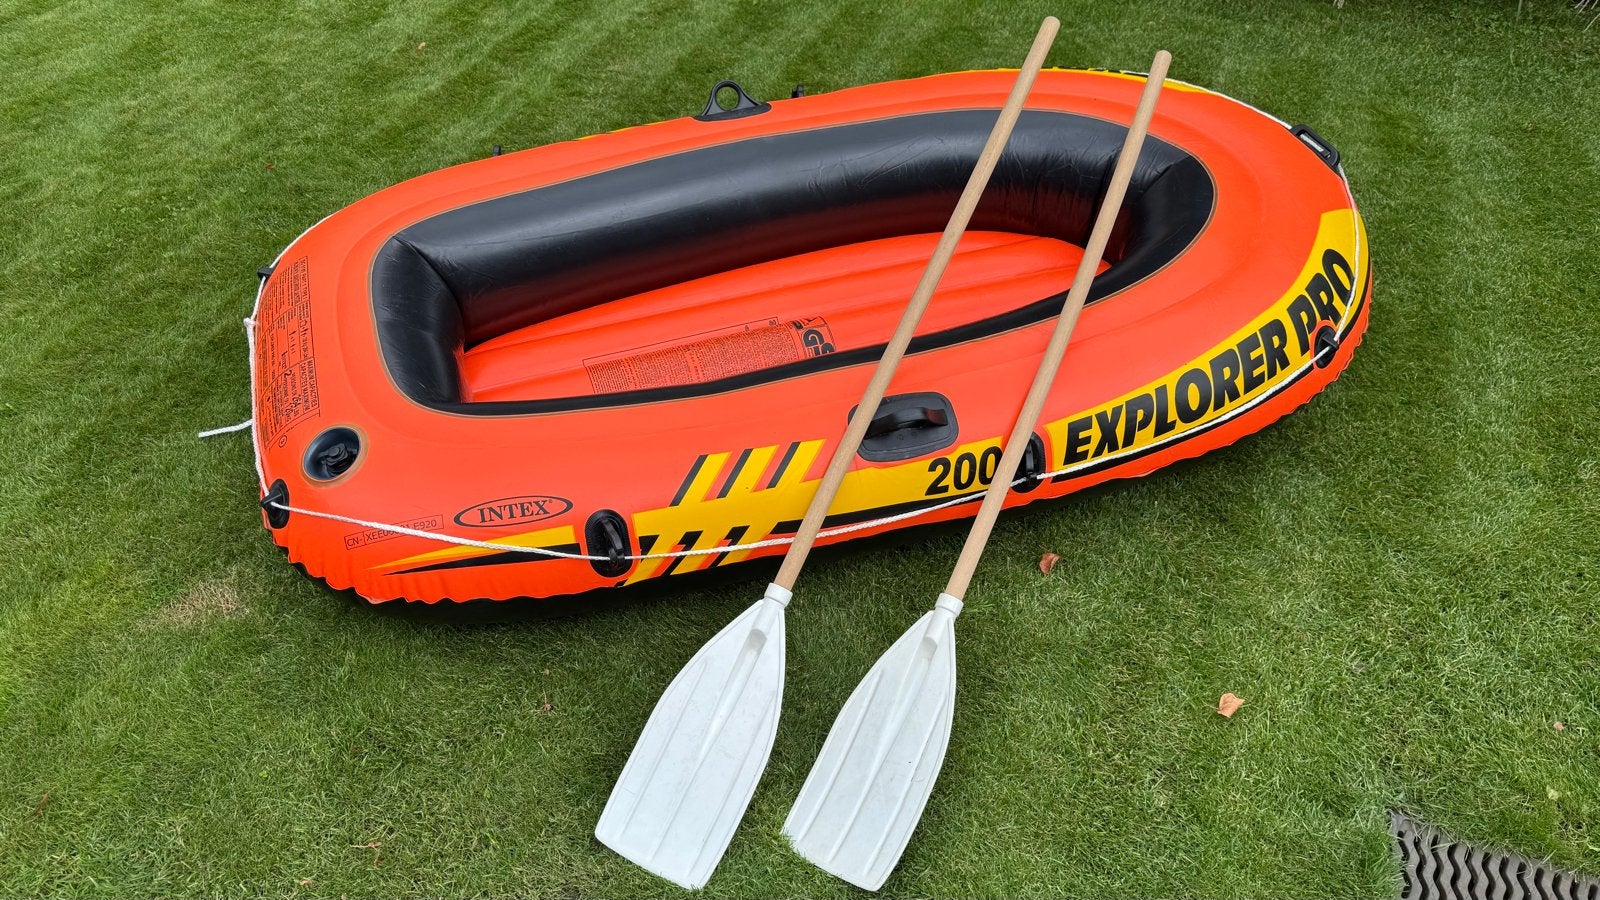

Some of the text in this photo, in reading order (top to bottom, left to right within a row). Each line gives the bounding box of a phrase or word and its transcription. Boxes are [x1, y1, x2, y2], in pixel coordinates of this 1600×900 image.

[1063, 248, 1356, 466] EXPLORER PRO
[924, 446, 1004, 496] 200
[477, 499, 551, 524] INTEX
